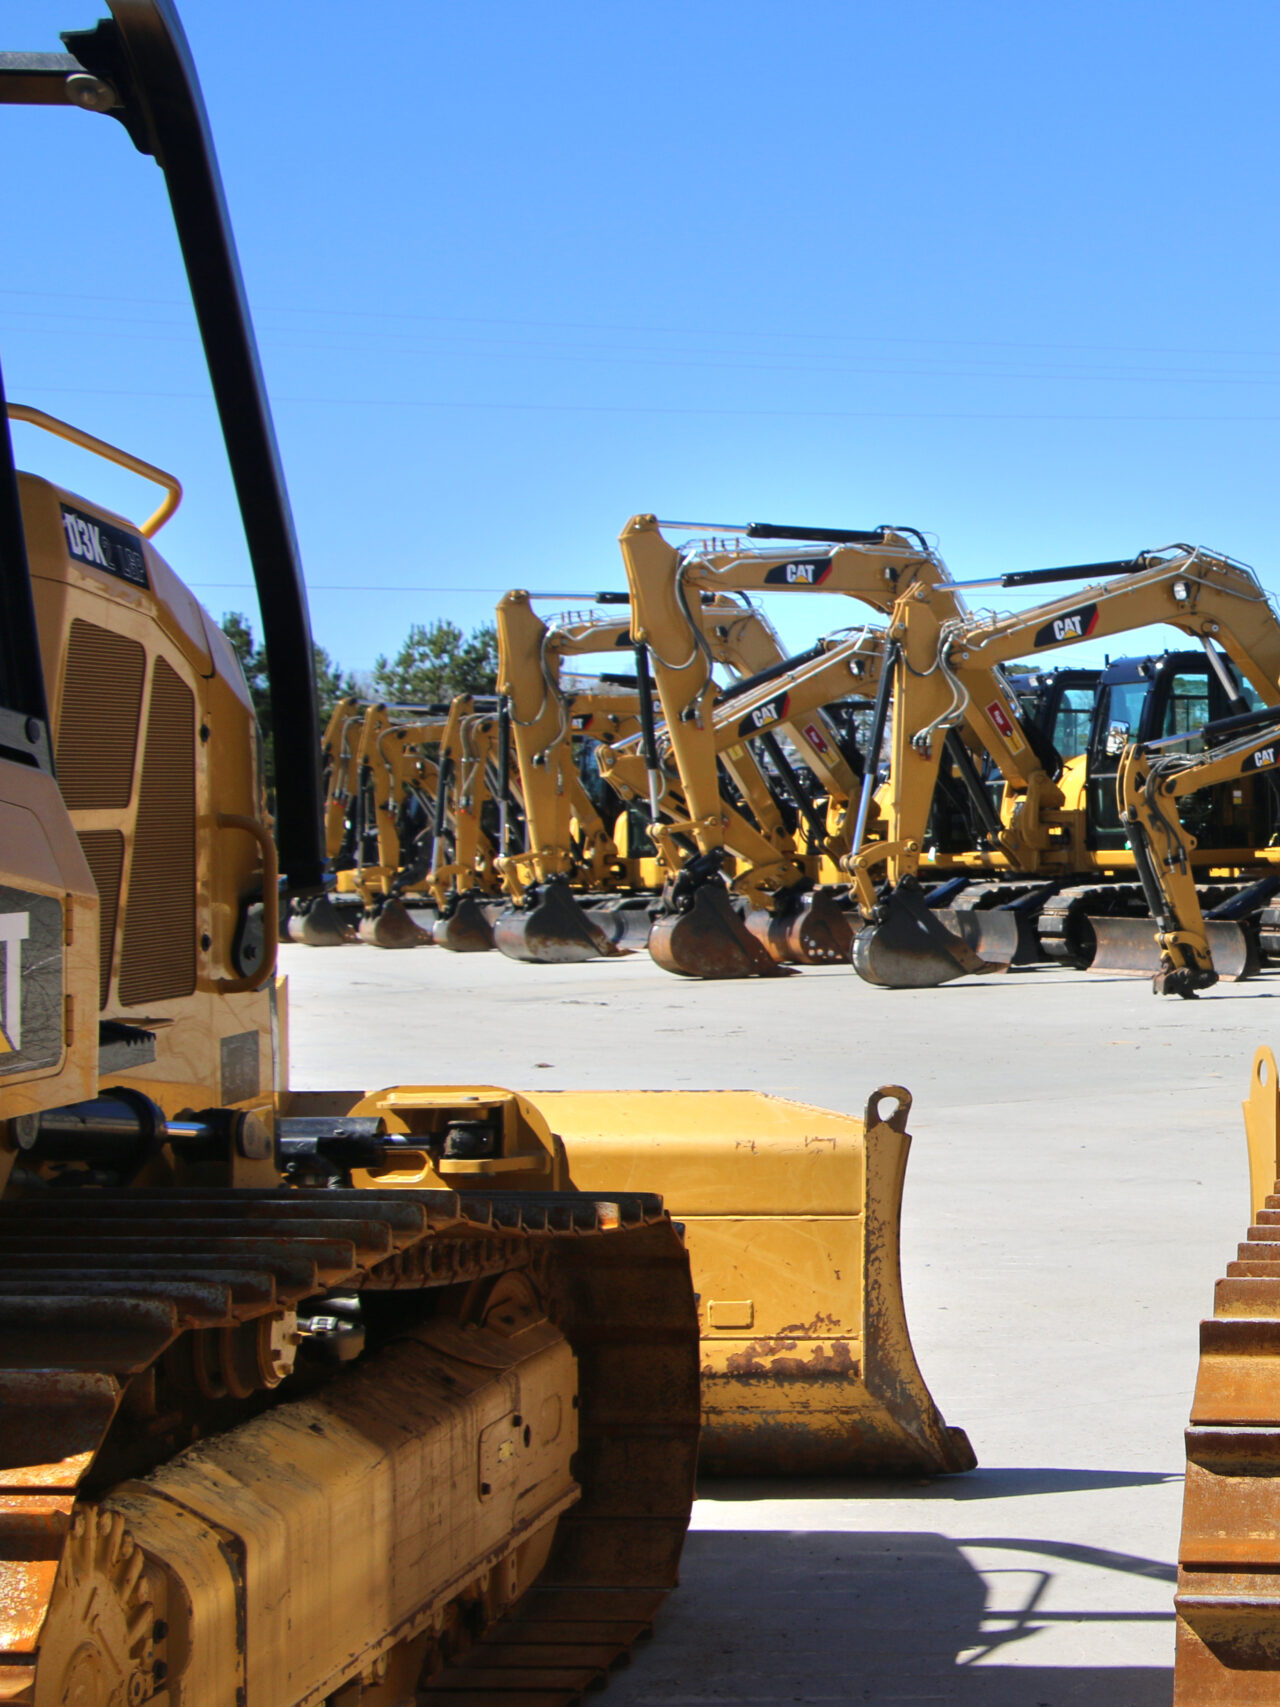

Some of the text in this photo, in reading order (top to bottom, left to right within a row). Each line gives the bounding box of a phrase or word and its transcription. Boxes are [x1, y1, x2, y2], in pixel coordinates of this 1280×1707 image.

[786, 564, 815, 583] CAT
[1053, 615, 1083, 640] CAT
[752, 703, 778, 727] CAT
[1254, 748, 1275, 767] CAT
